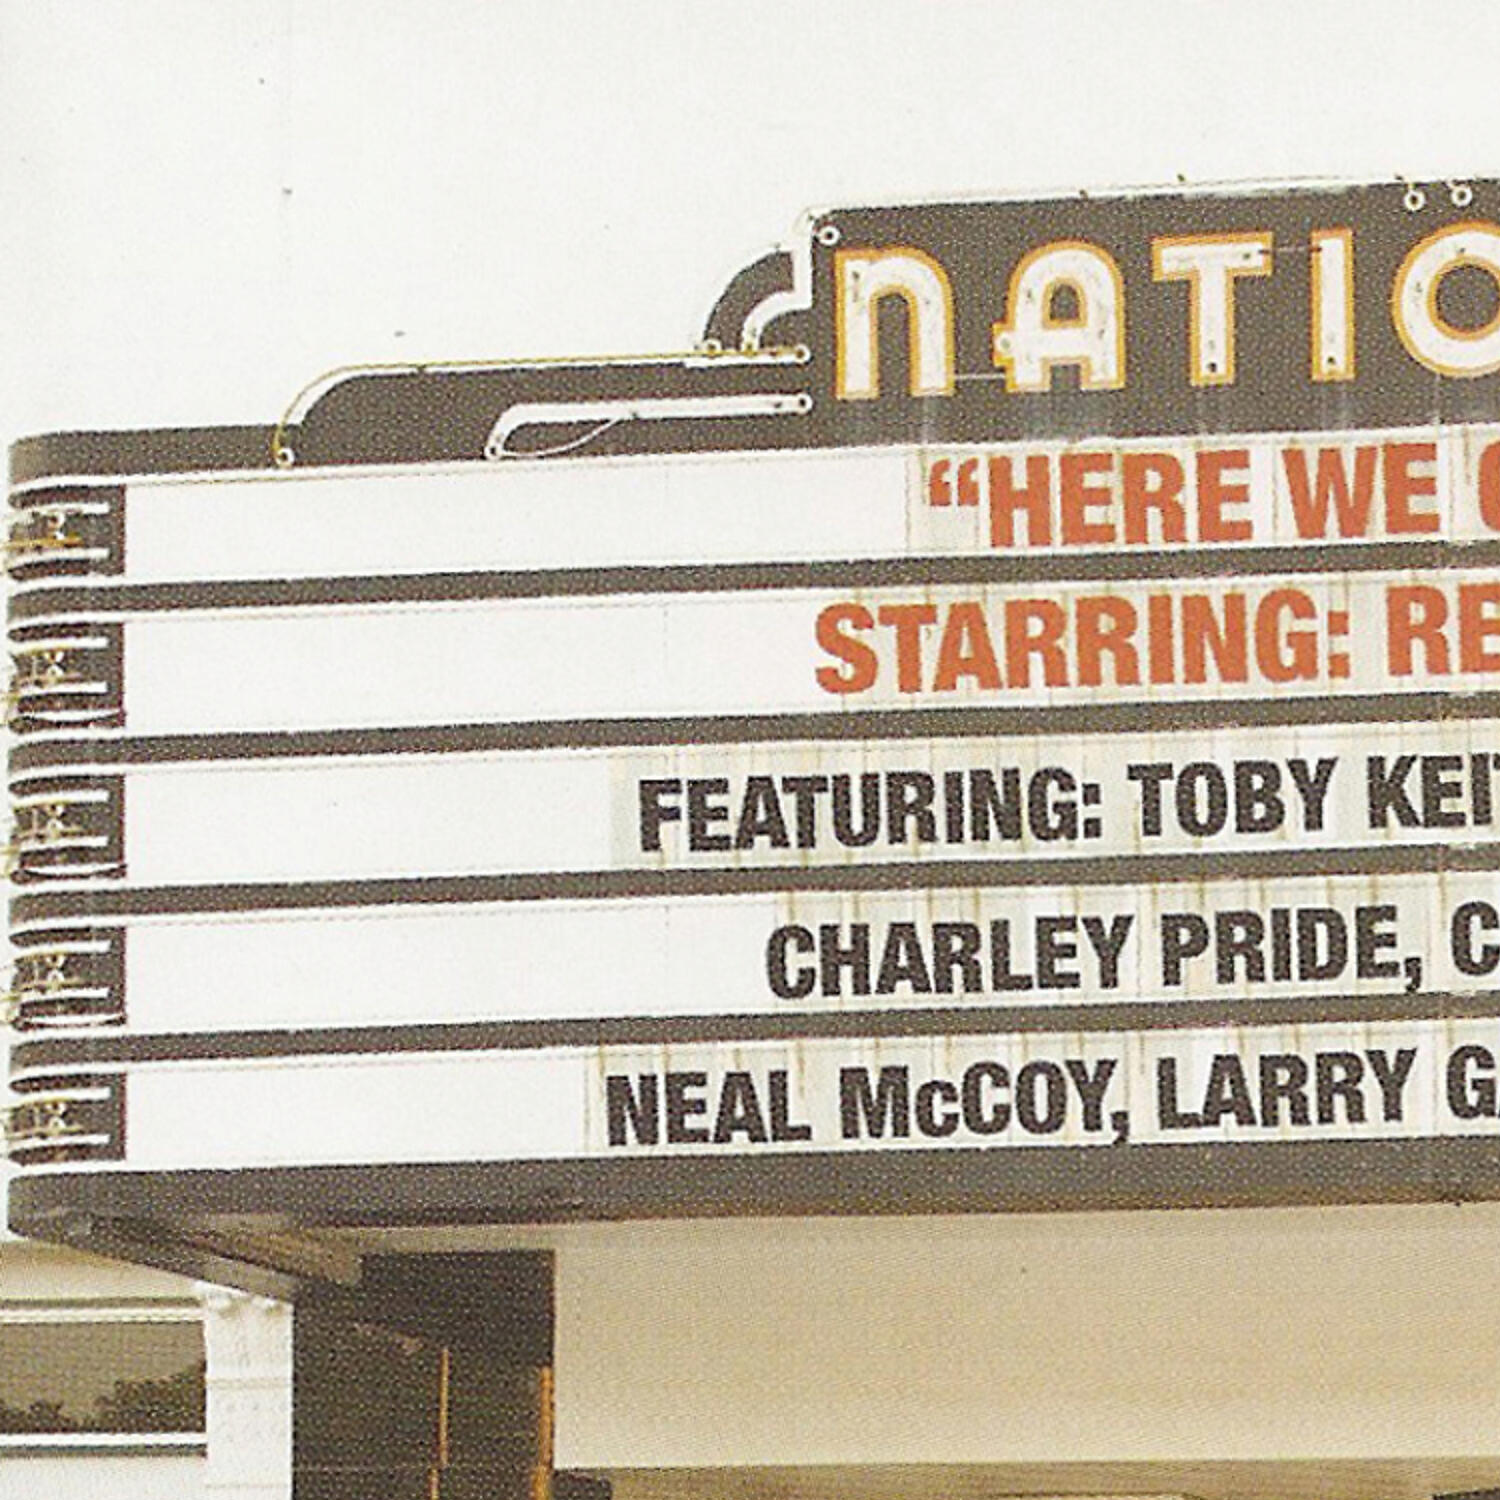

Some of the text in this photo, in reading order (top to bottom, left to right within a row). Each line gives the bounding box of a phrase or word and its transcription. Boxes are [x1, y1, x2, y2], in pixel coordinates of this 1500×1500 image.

[1283, 442, 1440, 539] WE
[817, 589, 1350, 694] STARRING:
[639, 767, 1102, 852] FEATURING:
[1127, 757, 1338, 837] TOBY
[767, 915, 1134, 1000] CHARLEY
[1161, 905, 1423, 993] PRIDE,
[606, 1070, 812, 1147] NEAL
[839, 1059, 1131, 1147] McCOY,
[1157, 1048, 1417, 1130] LARRY
